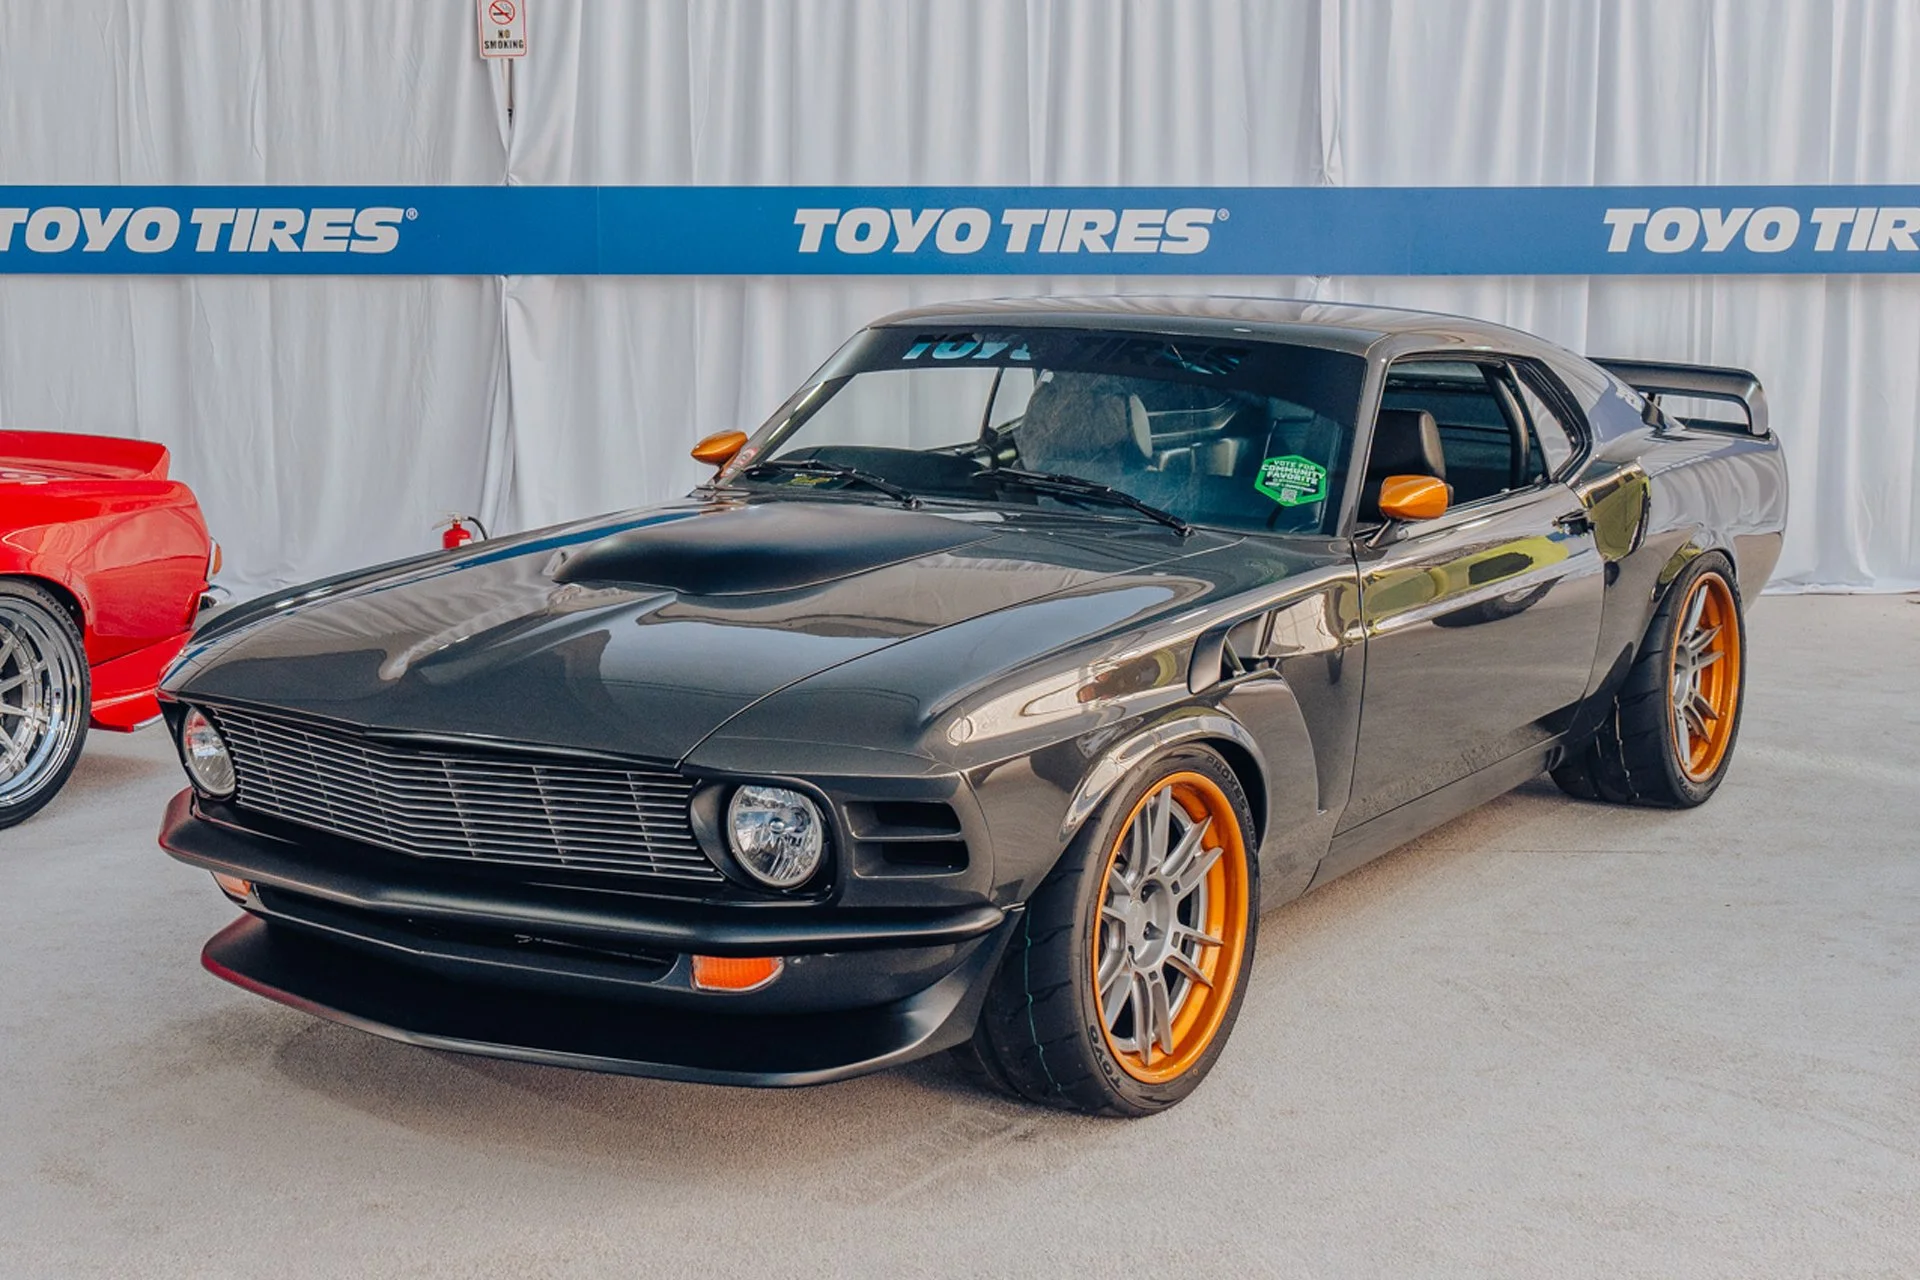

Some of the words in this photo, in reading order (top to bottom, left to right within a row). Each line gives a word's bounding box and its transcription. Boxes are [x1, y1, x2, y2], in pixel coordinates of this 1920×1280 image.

[497, 29, 510, 39] NO
[484, 40, 524, 50] SMOKING
[0, 206, 181, 253] TOYO
[793, 207, 991, 254] TOYO
[1603, 206, 1800, 253] TOYO
[1261, 464, 1325, 480] COMMUNITY
[1273, 460, 1297, 468] VOTE
[1266, 471, 1318, 485] FAVORITE
[1089, 1024, 1121, 1089] TOYO
